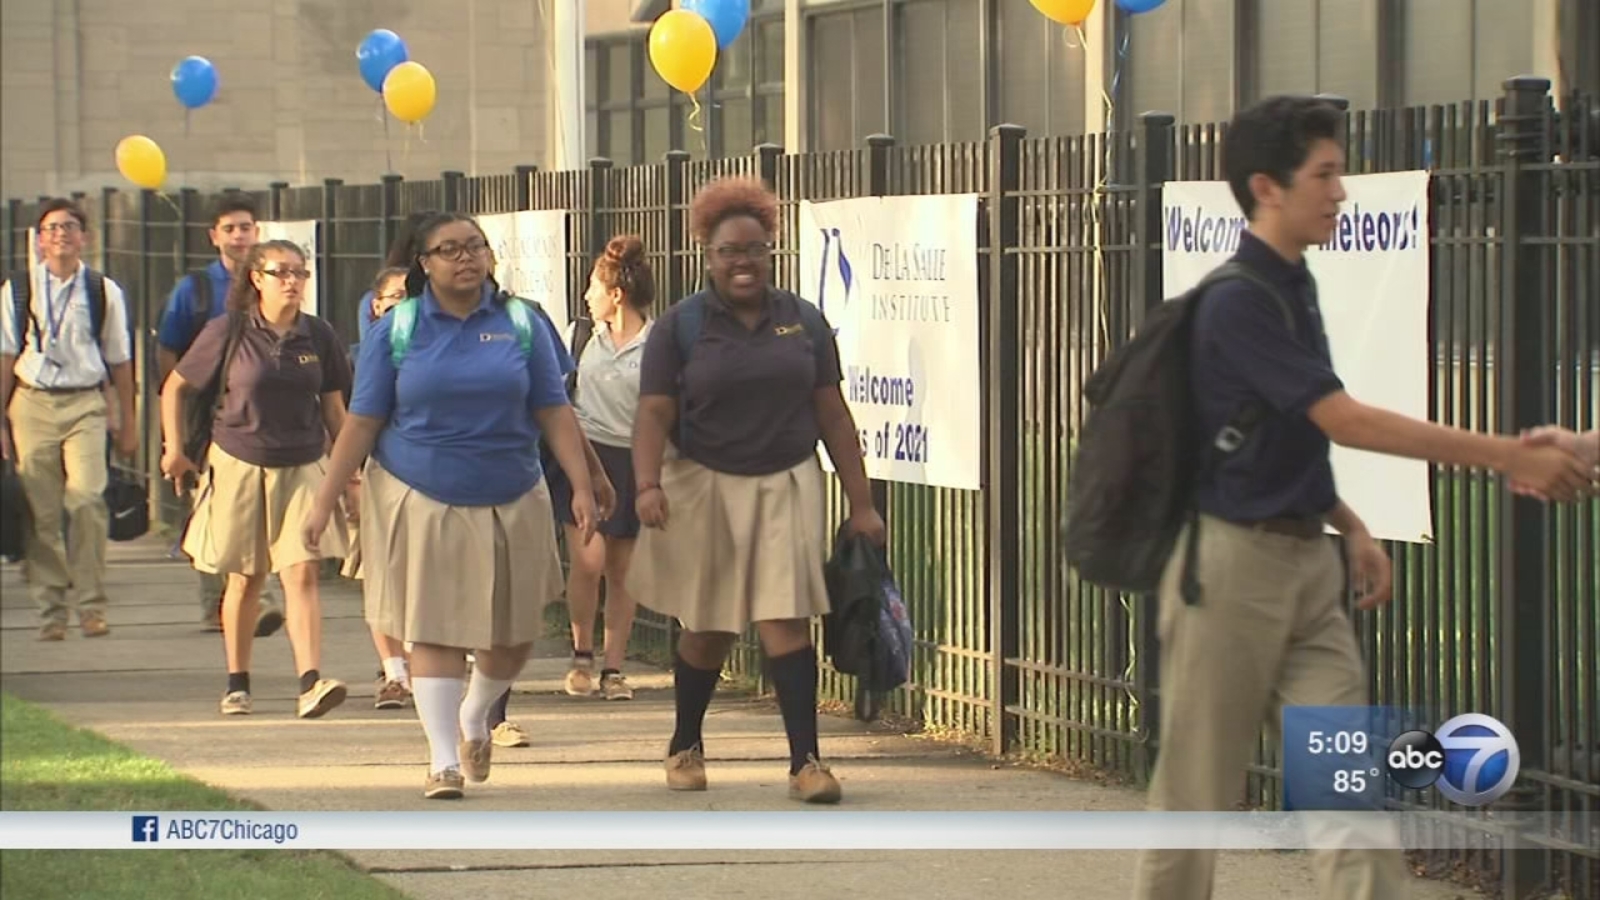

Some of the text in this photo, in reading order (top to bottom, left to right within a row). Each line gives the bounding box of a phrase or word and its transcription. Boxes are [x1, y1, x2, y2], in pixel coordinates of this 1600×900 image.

[1164, 205, 1246, 253] Welcom
[871, 293, 951, 323] INSTITUTE
[848, 366, 914, 407] Welcome
[874, 421, 890, 459] of
[895, 424, 928, 463] 2021
